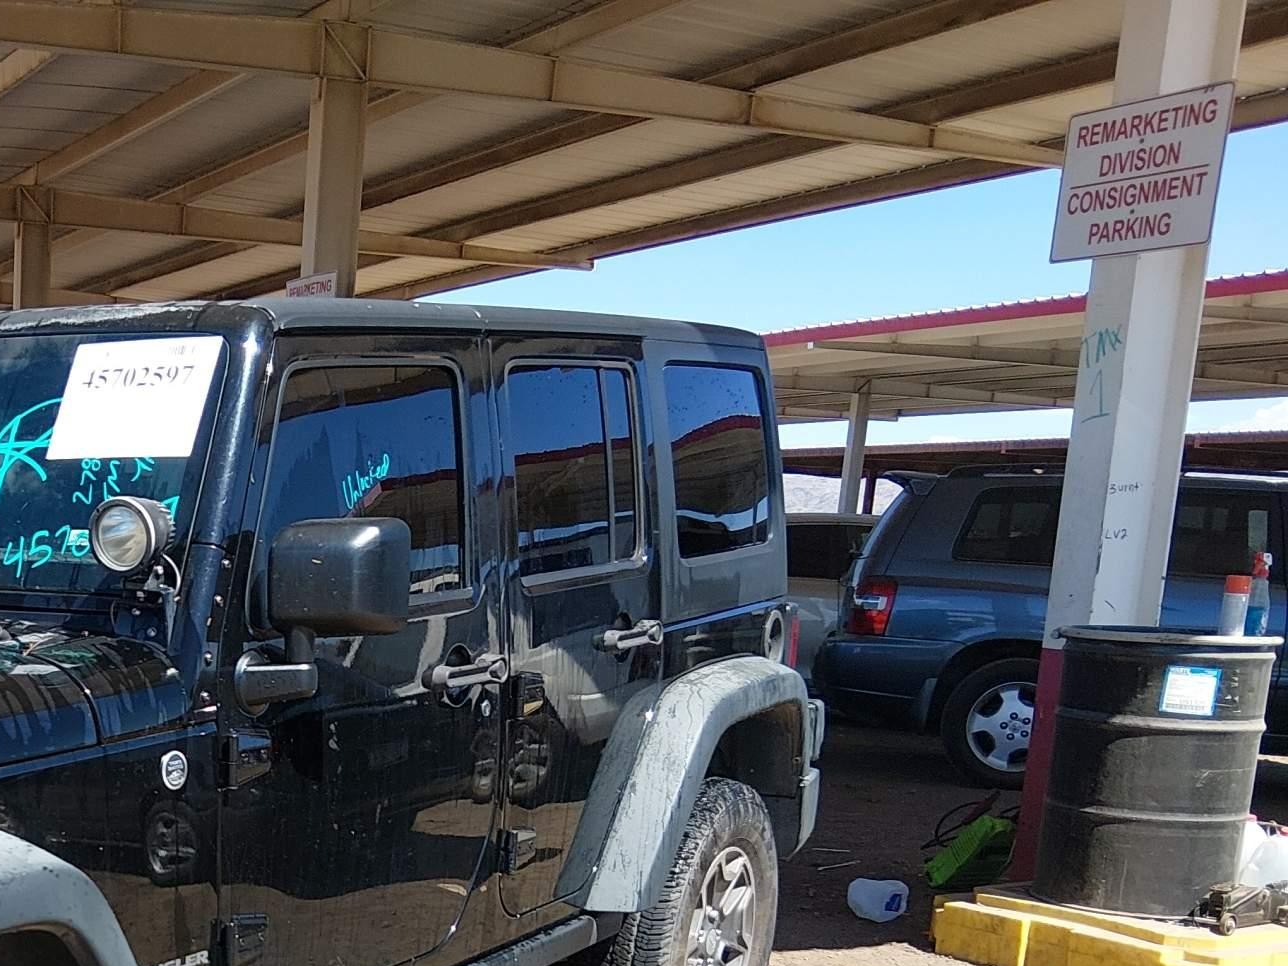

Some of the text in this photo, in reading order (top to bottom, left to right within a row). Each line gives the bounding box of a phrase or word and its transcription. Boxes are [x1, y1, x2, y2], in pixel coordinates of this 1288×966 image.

[1077, 99, 1218, 148] REMARKETING
[1099, 141, 1182, 177] DIVISION
[1067, 172, 1208, 215] CONSIGNMENT
[1088, 213, 1172, 245] PARKING
[82, 365, 195, 389] 45702597
